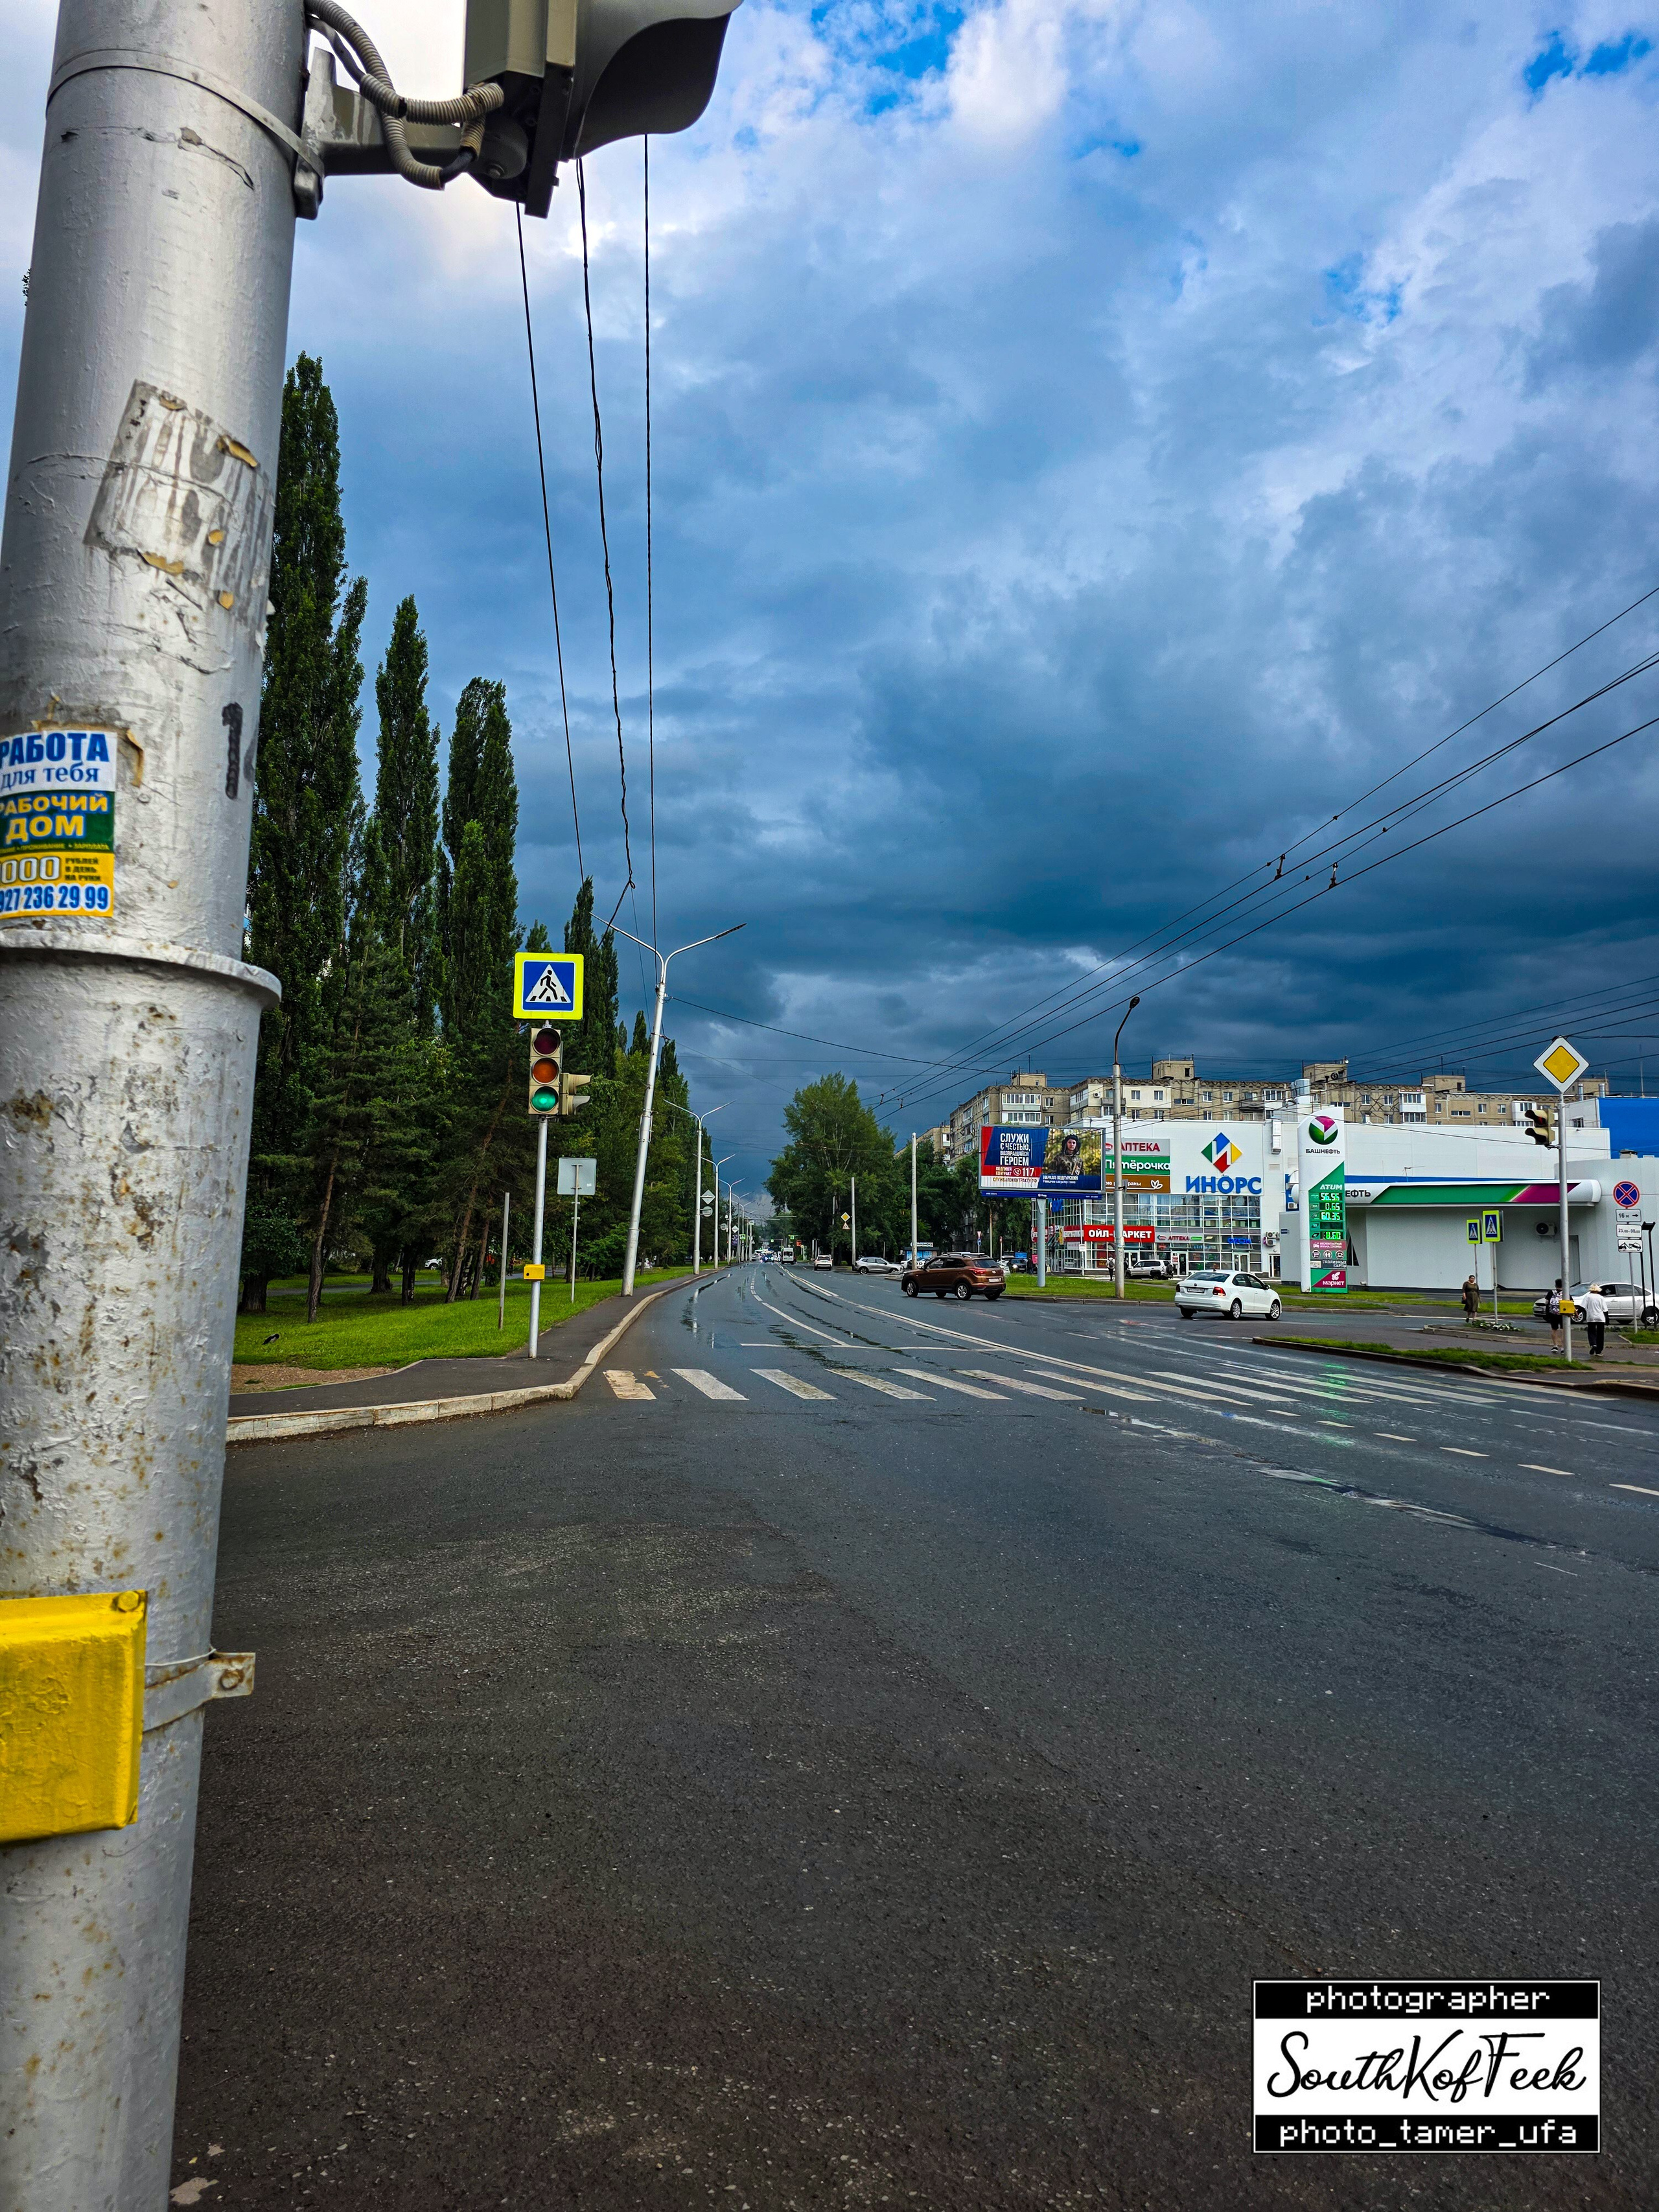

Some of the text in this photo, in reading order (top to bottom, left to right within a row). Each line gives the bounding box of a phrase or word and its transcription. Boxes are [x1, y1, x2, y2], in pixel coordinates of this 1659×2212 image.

[0, 732, 110, 769] РАБОТА
[0, 762, 100, 791] для тебя
[5, 815, 84, 843] ДОМ
[0, 856, 61, 884] 000
[23, 885, 54, 909] 236
[58, 885, 80, 909] 29
[85, 886, 108, 910] 99
[1000, 1133, 1029, 1143] СЛУЖИ
[1005, 1143, 1030, 1152] ЧЕСТЬЮ,
[1000, 1156, 1029, 1166] ГЕРОЕМ
[1105, 1159, 1170, 1172] Птёрочка
[1022, 1167, 1035, 1177] 117
[1186, 1175, 1262, 1194] ИНОРС
[1088, 1228, 1152, 1239] ОЙЛ-АРКЕТ
